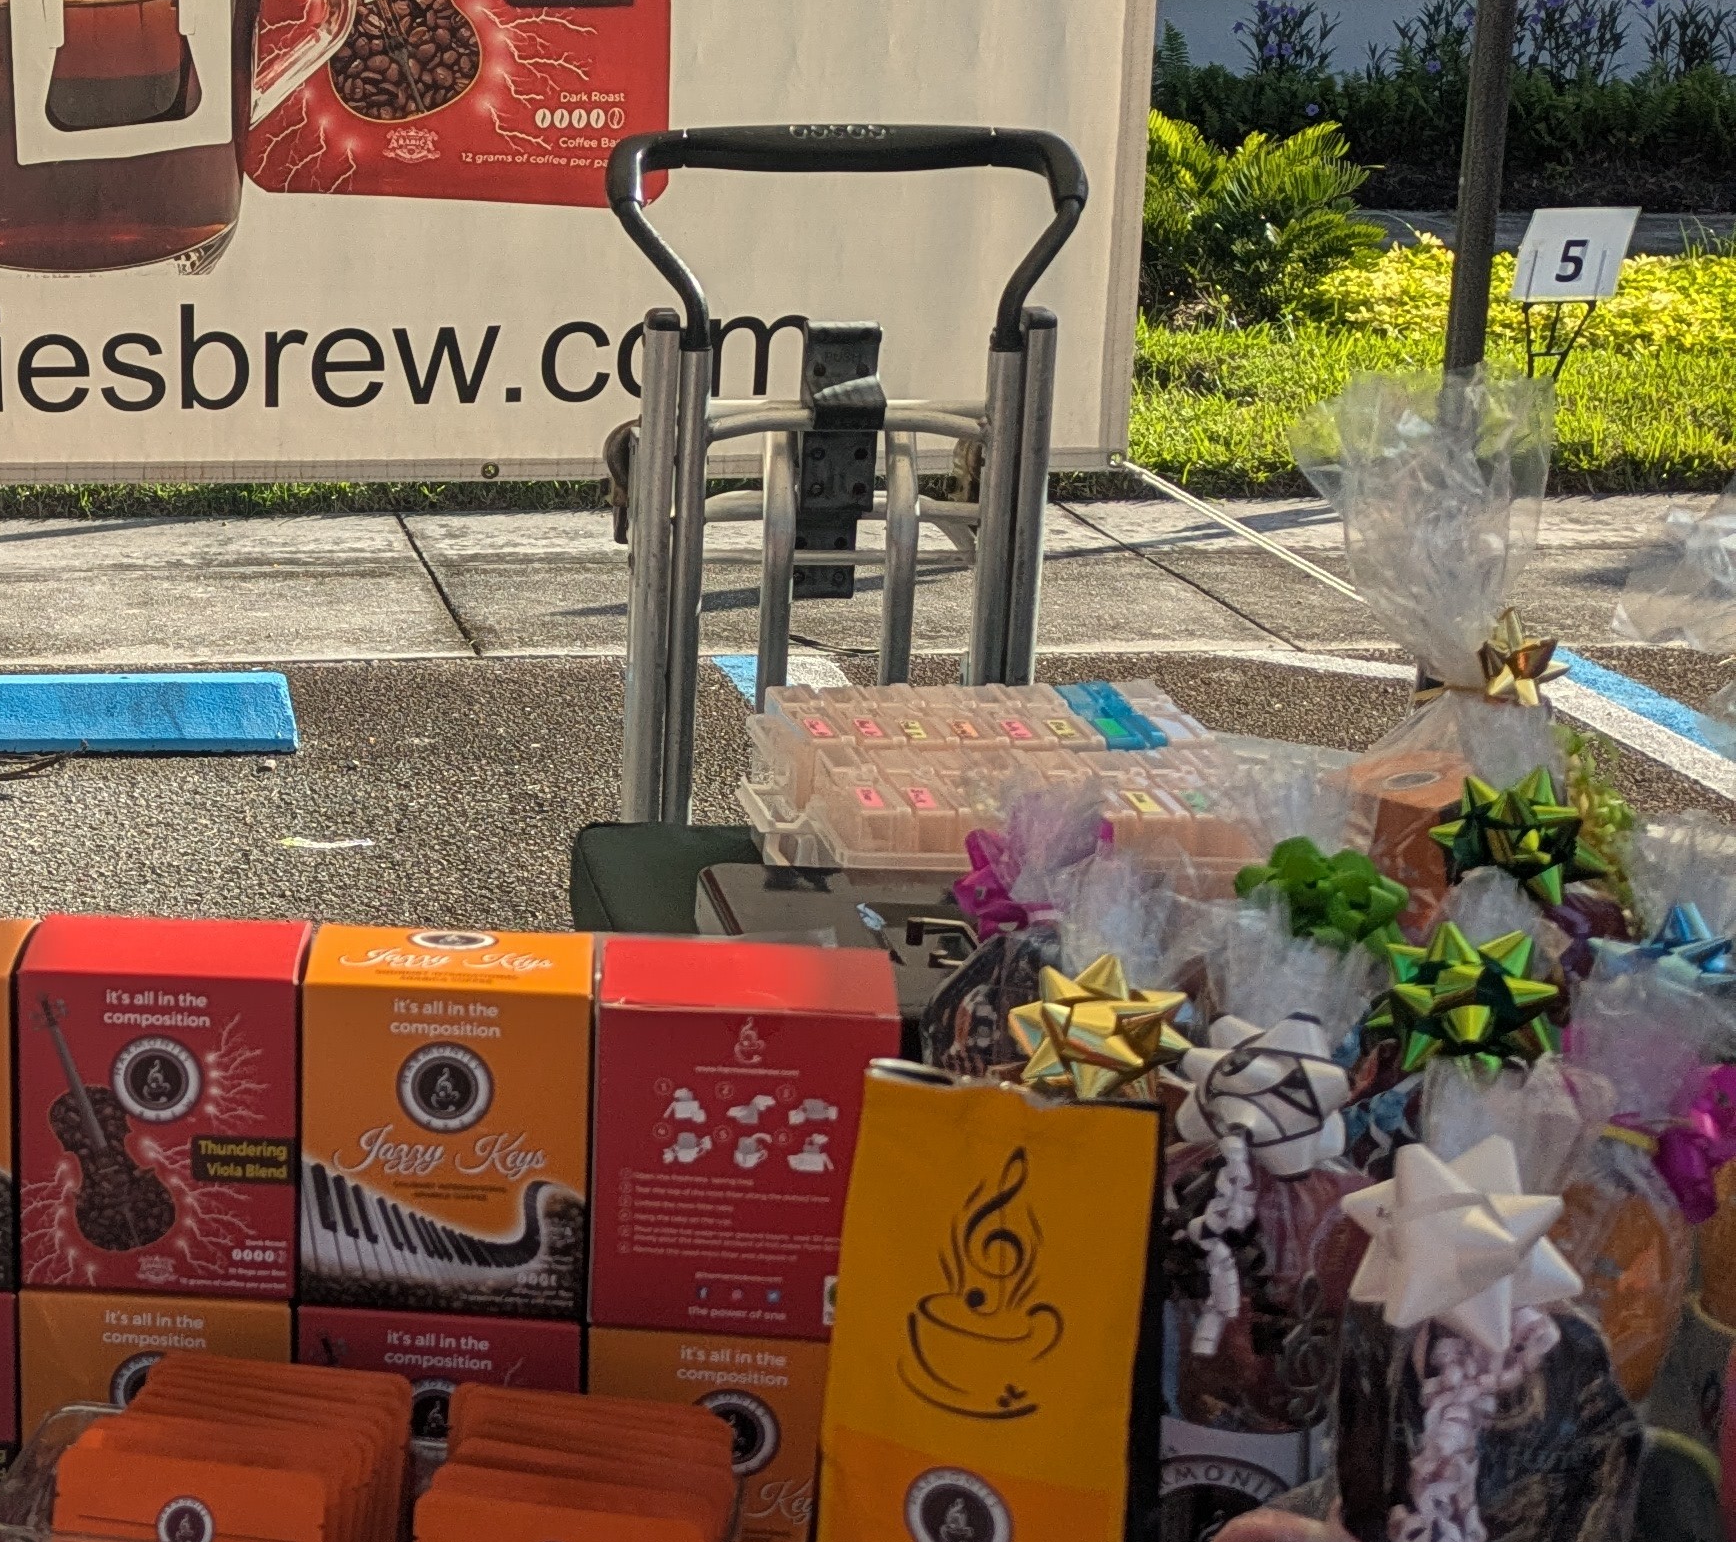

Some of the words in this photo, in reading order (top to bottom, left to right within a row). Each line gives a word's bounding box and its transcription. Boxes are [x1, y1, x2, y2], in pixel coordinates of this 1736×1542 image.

[560, 92, 589, 102] Dark
[591, 92, 624, 102] Roast
[559, 138, 597, 147] Coffee
[461, 153, 473, 161] 12
[476, 153, 512, 163] grams
[515, 154, 528, 162] of
[530, 154, 567, 165] coffee
[570, 157, 591, 167] per
[1555, 239, 1588, 283] 5
[339, 948, 451, 968] Jazzy
[462, 953, 553, 971] Keys
[106, 989, 130, 1004] it's
[134, 991, 154, 1006] all
[158, 991, 175, 1006] in
[179, 994, 207, 1008] the
[394, 999, 418, 1013] it's
[423, 1001, 443, 1015] all
[448, 1001, 464, 1015] in
[468, 1002, 498, 1018] the
[103, 1011, 210, 1027] composition
[390, 1021, 501, 1038] composition
[198, 1140, 288, 1160] Thundering
[333, 1124, 445, 1175] Jazzy
[455, 1132, 547, 1181] Keys
[206, 1163, 242, 1177] Viola
[245, 1164, 288, 1178] Blend
[104, 1309, 128, 1325] it's
[132, 1312, 152, 1327] all
[157, 1314, 172, 1328] in
[176, 1315, 204, 1330] the
[102, 1330, 206, 1350] composition
[387, 1329, 411, 1345] it's
[415, 1332, 435, 1347] all
[439, 1333, 455, 1349] in
[460, 1335, 490, 1352] the
[384, 1351, 492, 1372] composition
